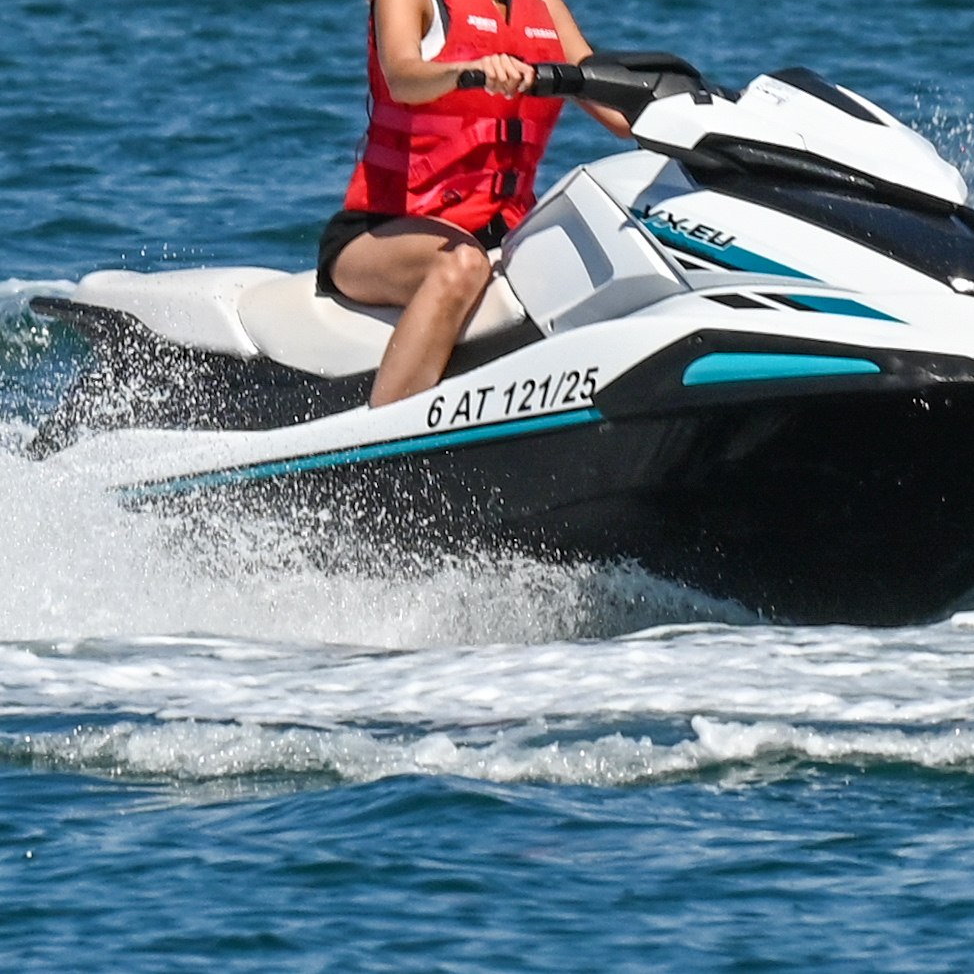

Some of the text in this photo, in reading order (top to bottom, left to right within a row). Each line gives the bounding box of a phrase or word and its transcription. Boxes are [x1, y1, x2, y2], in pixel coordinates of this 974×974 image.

[427, 366, 599, 428] 6 AT 121/25
